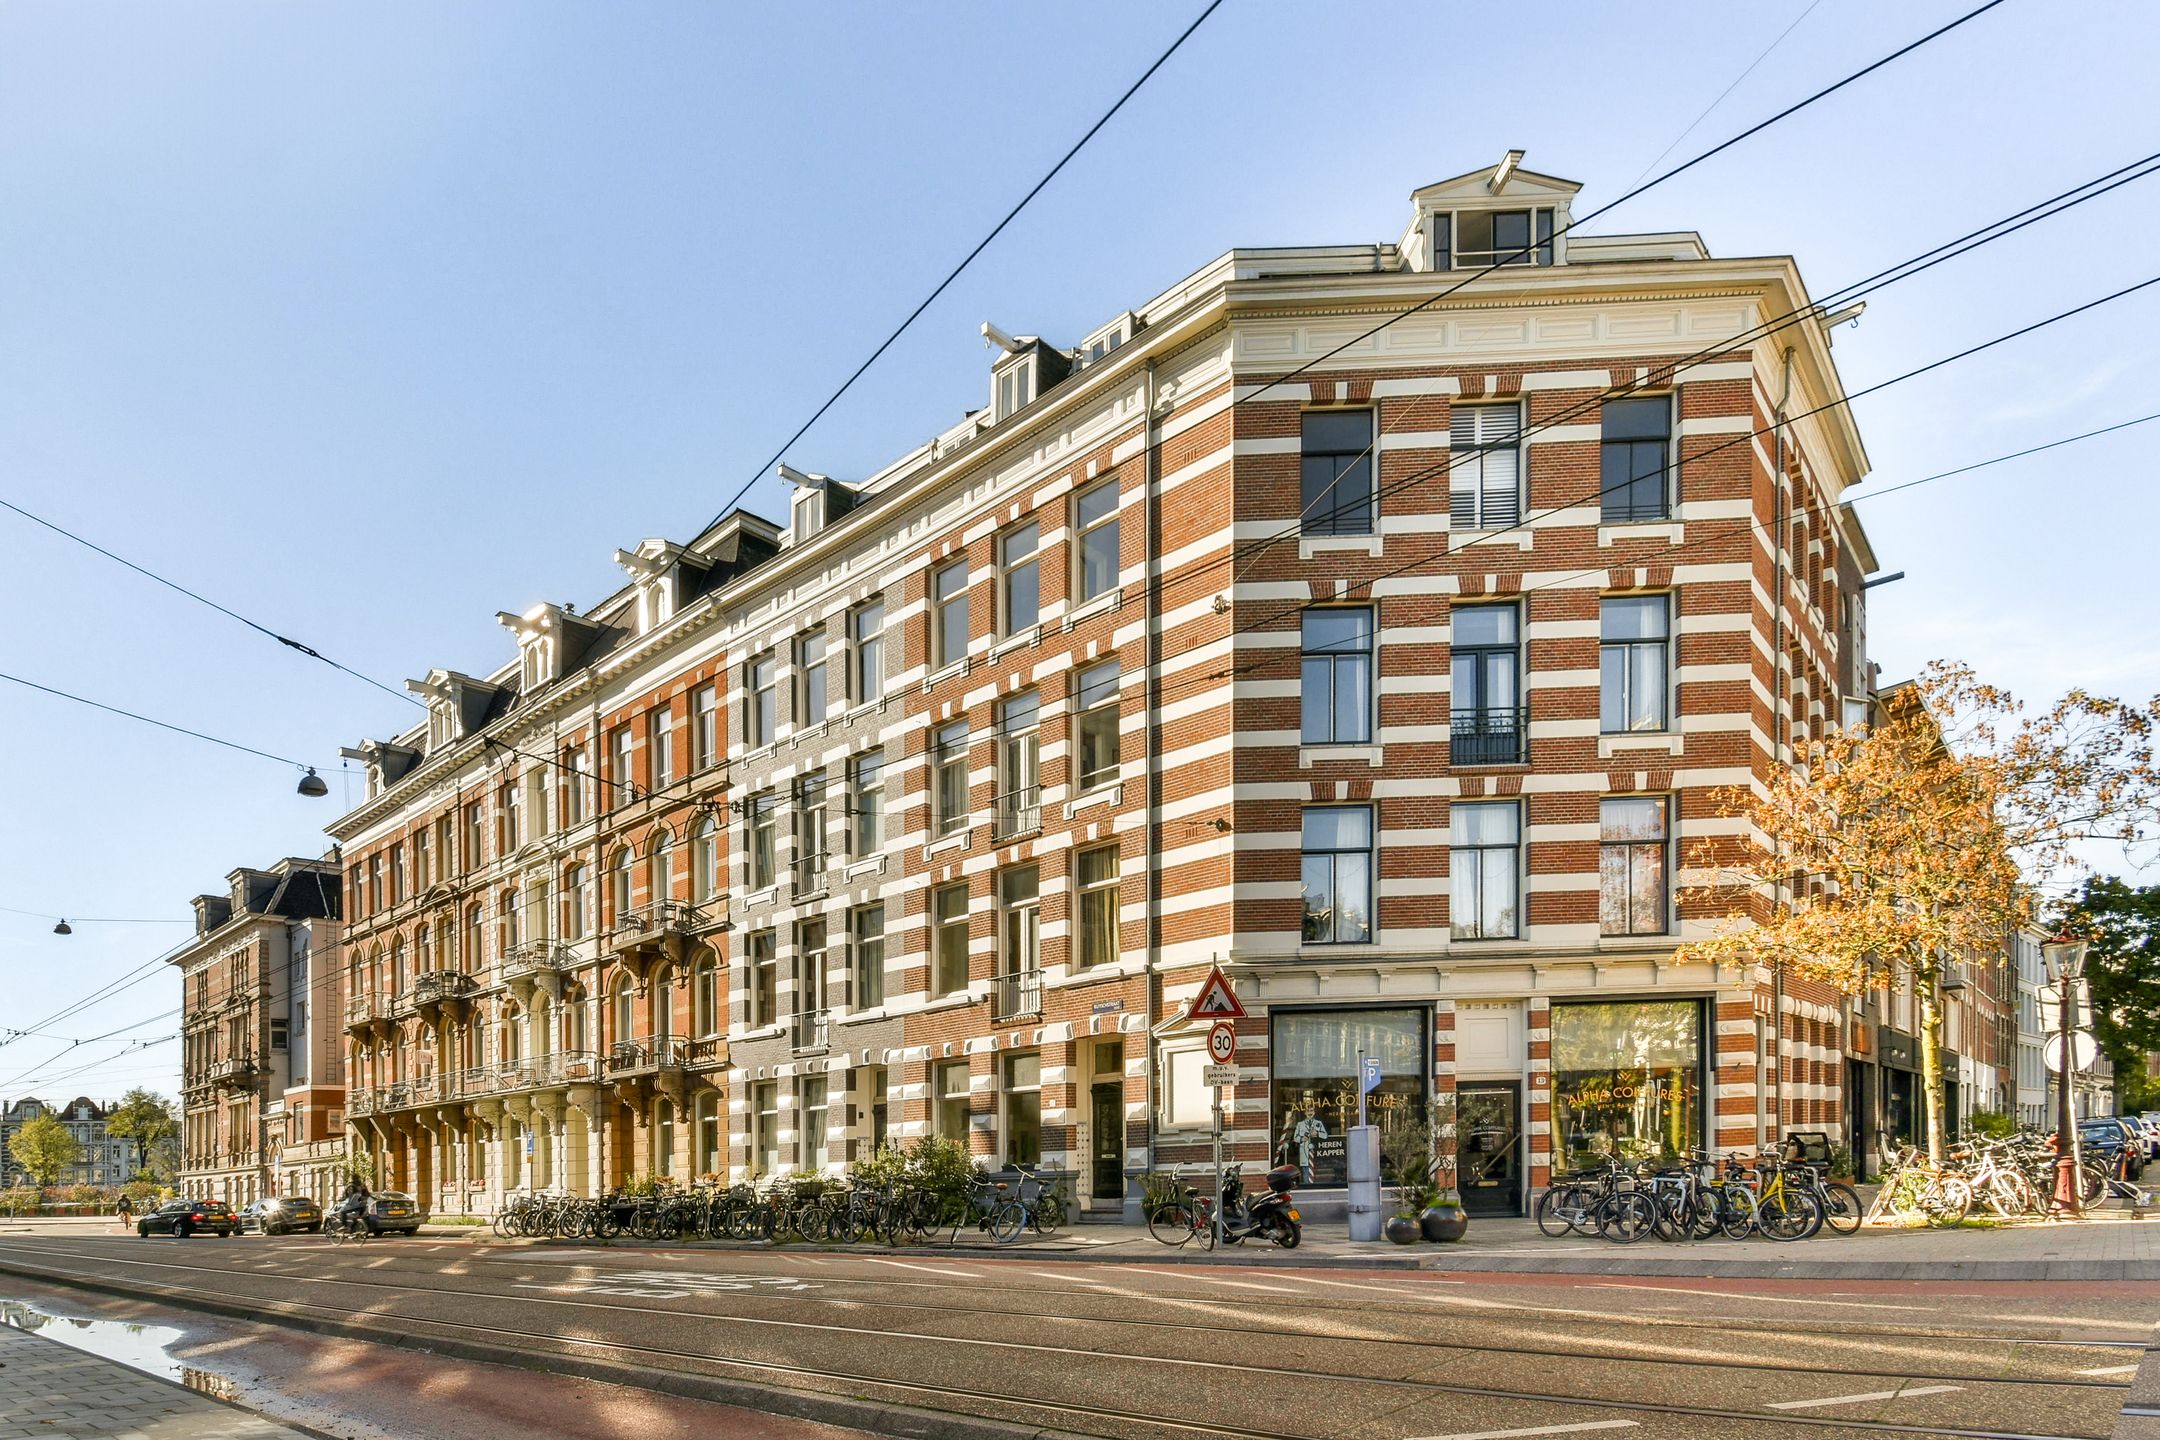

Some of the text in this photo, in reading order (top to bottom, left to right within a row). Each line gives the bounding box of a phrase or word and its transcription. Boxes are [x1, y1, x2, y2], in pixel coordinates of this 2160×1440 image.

[1214, 1035, 1231, 1051] 30
[1368, 1067, 1376, 1081] P
[1290, 1096, 1331, 1113] ALPHA
[1568, 1089, 1608, 1106] ALPHA
[1318, 1141, 1342, 1149] HEREN
[1317, 1149, 1345, 1157] KAPPER
